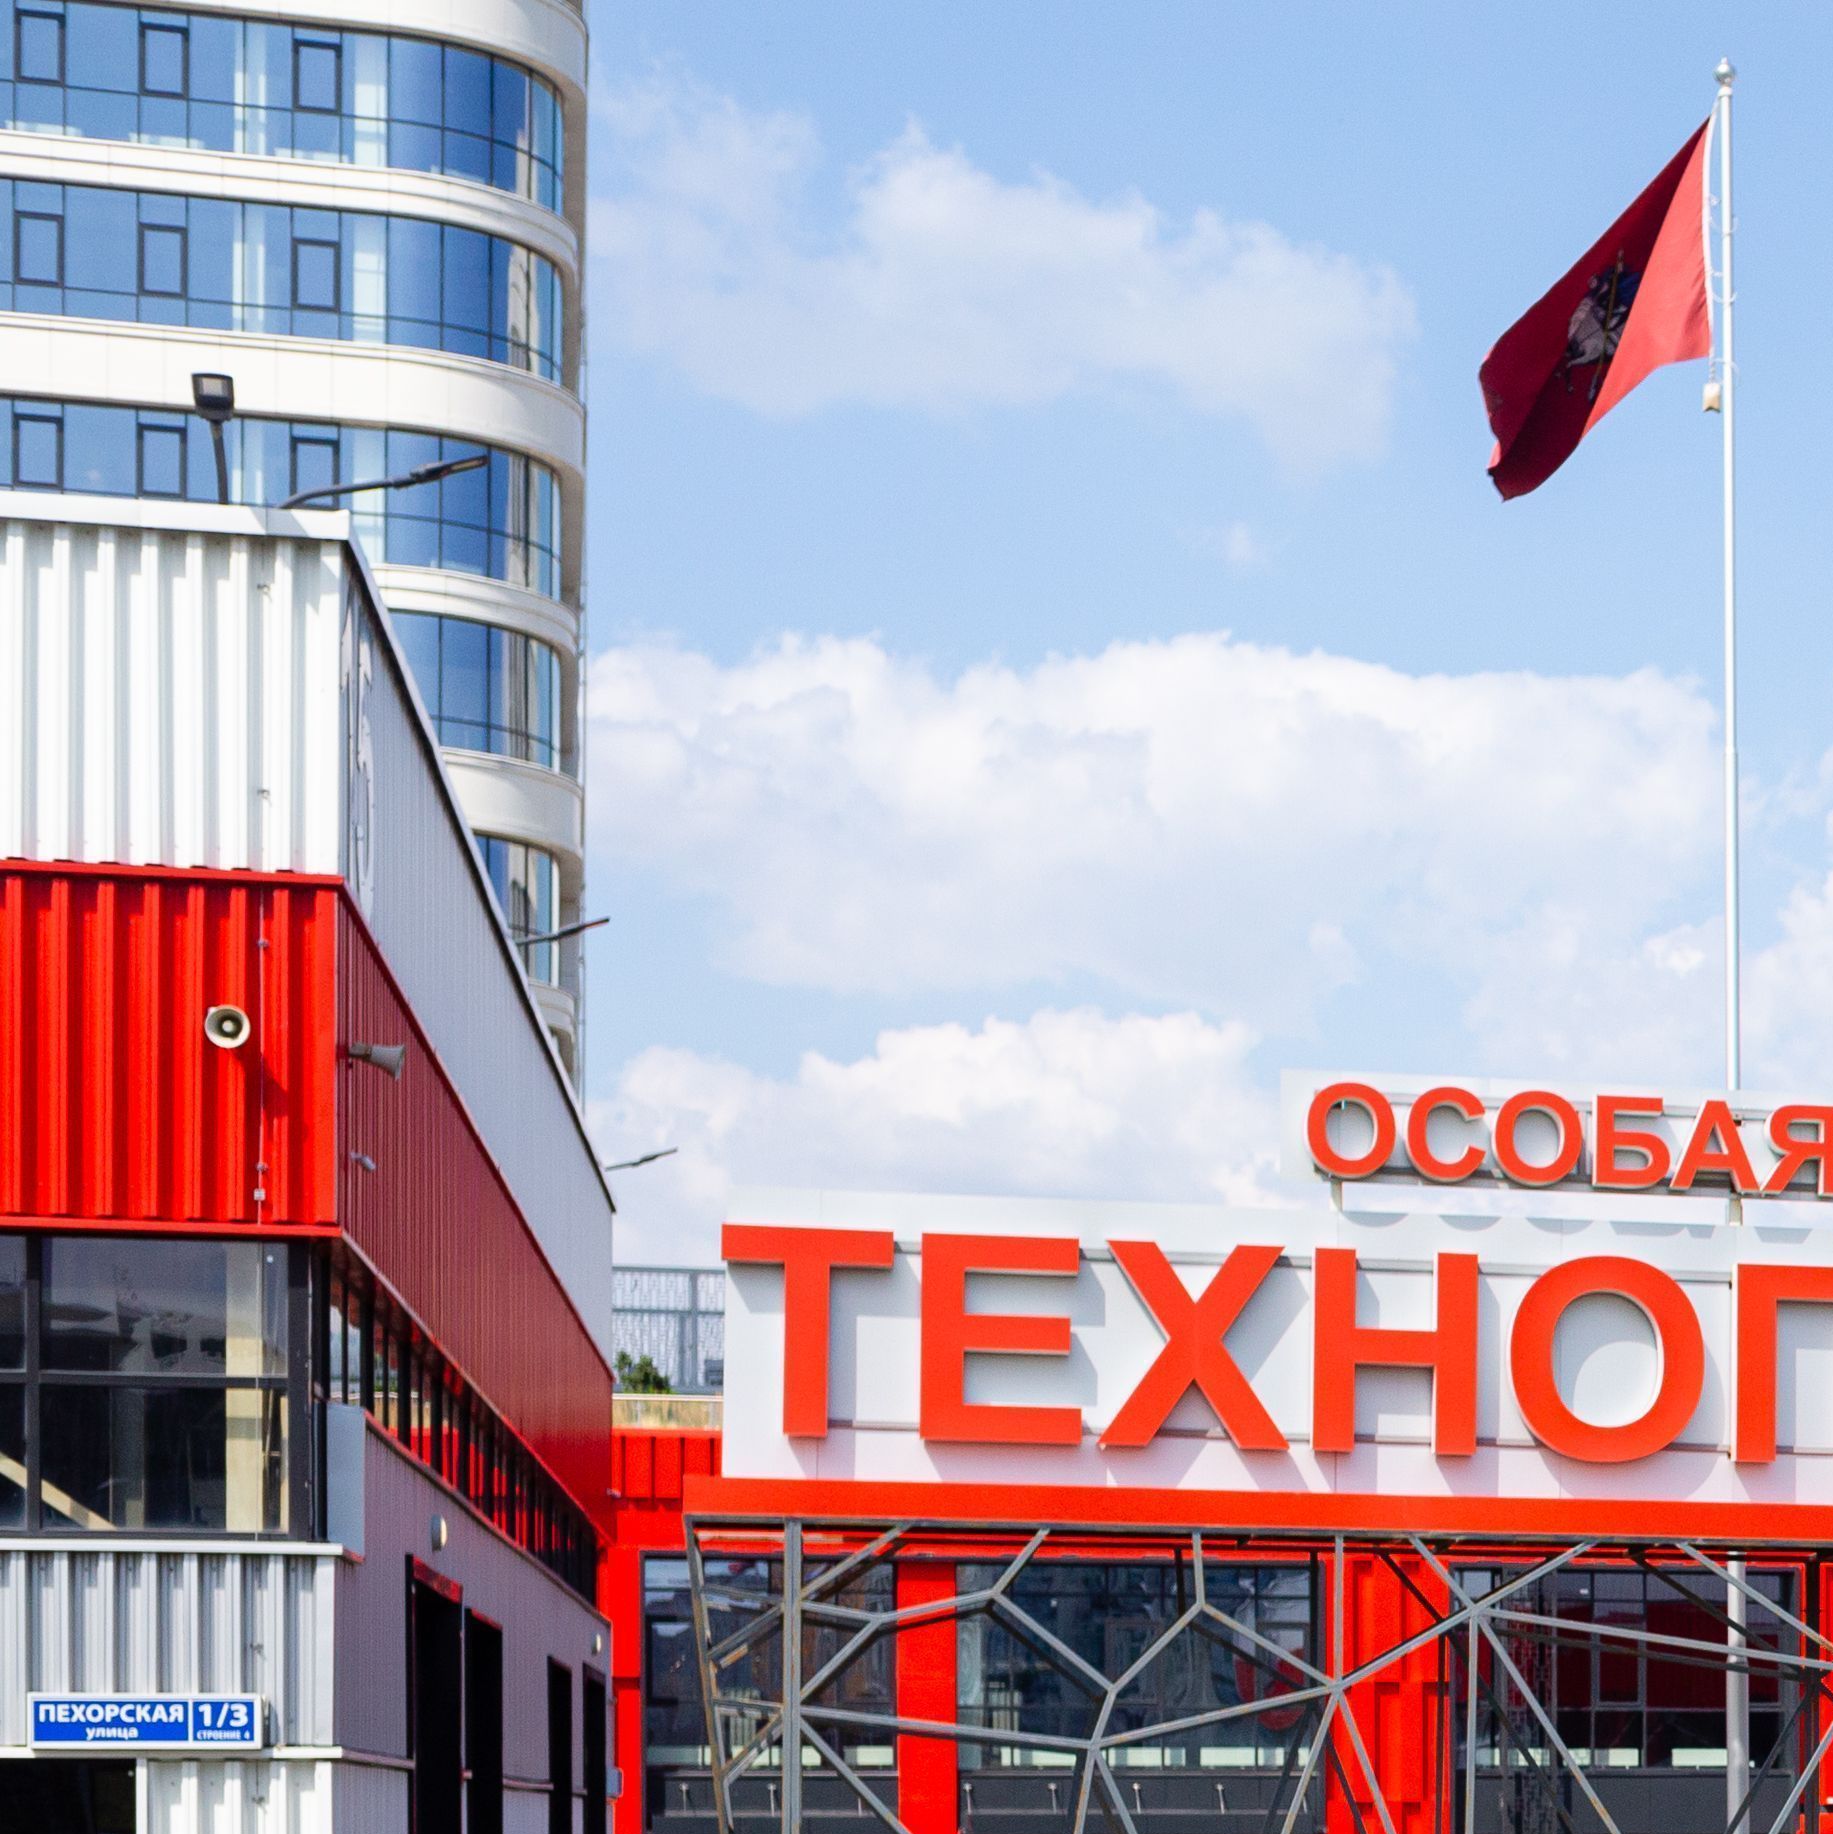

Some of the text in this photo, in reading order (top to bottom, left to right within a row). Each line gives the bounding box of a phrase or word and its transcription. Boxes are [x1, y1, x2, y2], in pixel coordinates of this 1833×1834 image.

[38, 1704, 184, 1723] ПЕХОРСКАЯ
[198, 1702, 249, 1728] 1/3
[85, 1725, 139, 1742] улица
